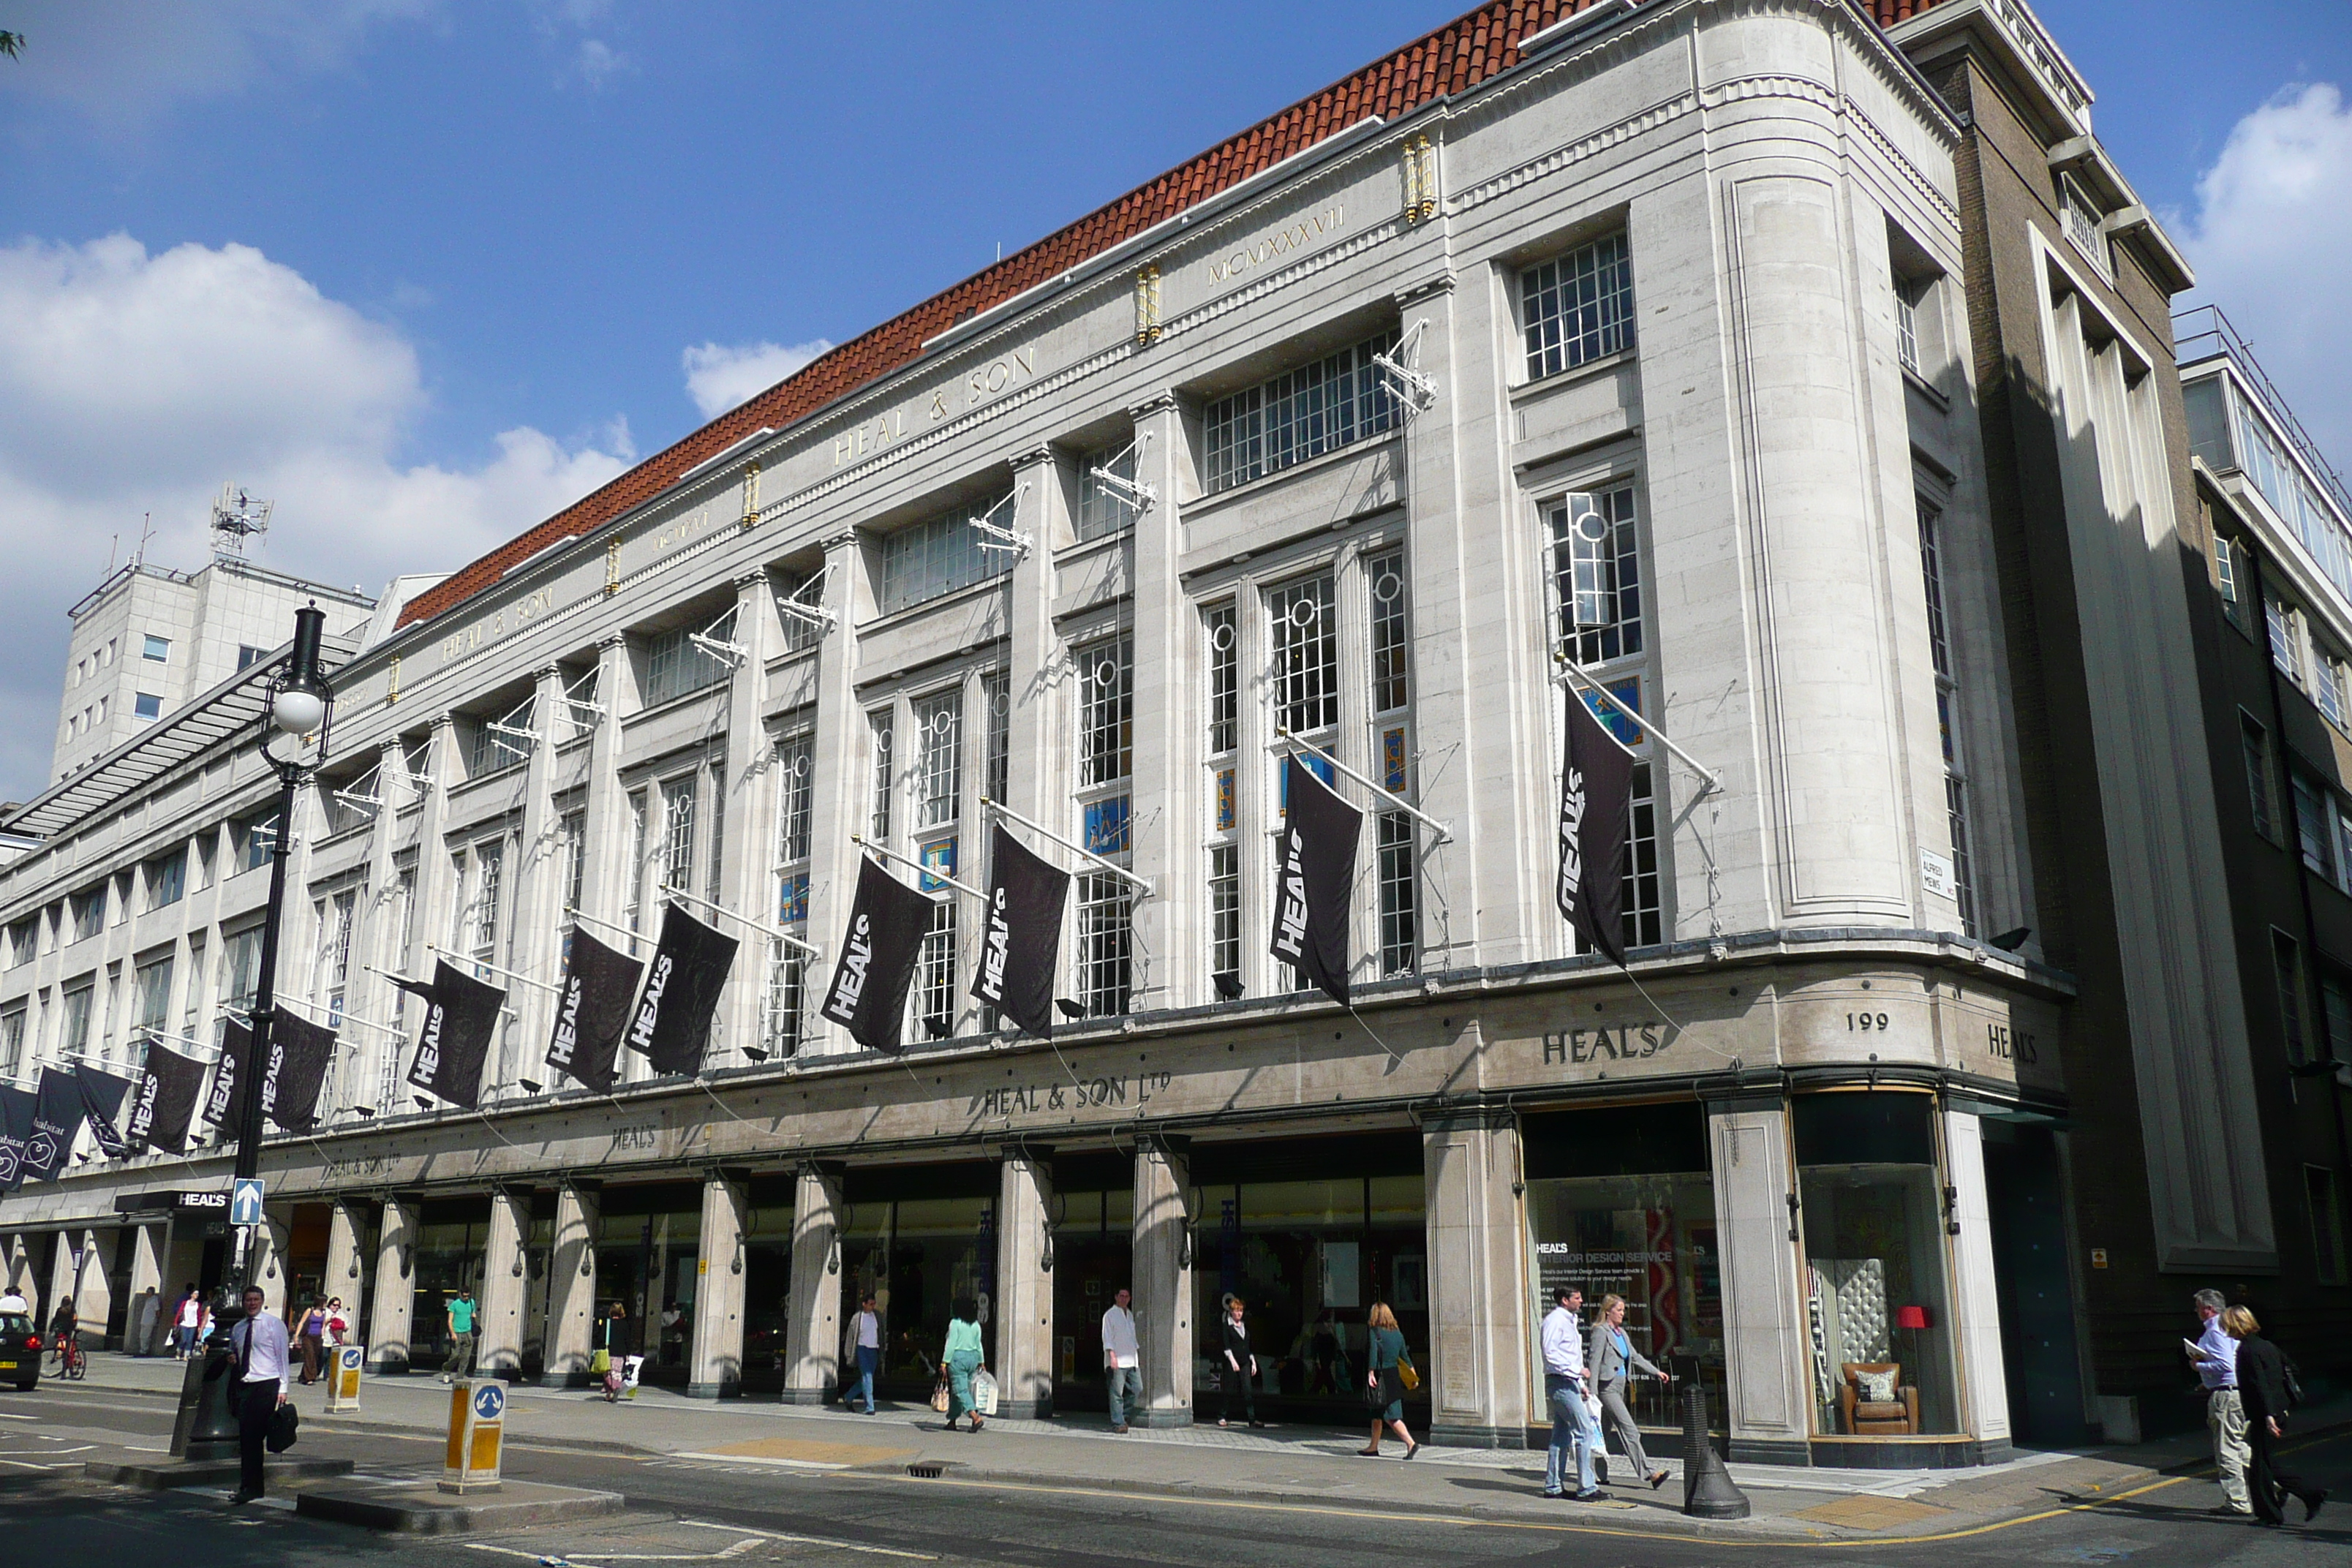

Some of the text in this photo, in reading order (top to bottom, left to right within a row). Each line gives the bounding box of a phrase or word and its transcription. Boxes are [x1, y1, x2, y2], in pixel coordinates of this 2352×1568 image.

[1208, 203, 1344, 287] MCMXXXVII
[834, 346, 1033, 467] HEAL & SON
[442, 587, 552, 663] HEAL & SON
[1580, 679, 1636, 699] ETWORK
[1923, 860, 1943, 878] ALFRED
[1923, 875, 1942, 891] MEWS
[829, 913, 872, 1021] HEAL'S
[549, 975, 581, 1066] HEAL'S
[630, 954, 673, 1048] HEAL'S
[1846, 1011, 1889, 1032] 199
[412, 1003, 444, 1085] HEAL'S
[1542, 1022, 1659, 1066] HEAL'S
[1987, 1023, 2038, 1063] HEAL'S
[207, 1054, 236, 1122] HEAL'S
[261, 1043, 284, 1113] HEAL'S
[984, 1085, 1041, 1117] HEAL
[1047, 1082, 1065, 1110] &
[1076, 1074, 1127, 1109] SON
[130, 1074, 159, 1137] HEAL'S
[0, 1134, 26, 1149] abitat
[33, 1116, 65, 1137] habitat
[613, 1124, 657, 1151] HEAL'S
[354, 1157, 361, 1175] &
[364, 1154, 385, 1175] SON
[179, 1193, 226, 1207] HEAL'S
[1536, 1243, 1568, 1254] HEAL'S
[1537, 1251, 1672, 1264] INTERIOR DESIGN SERVICE
